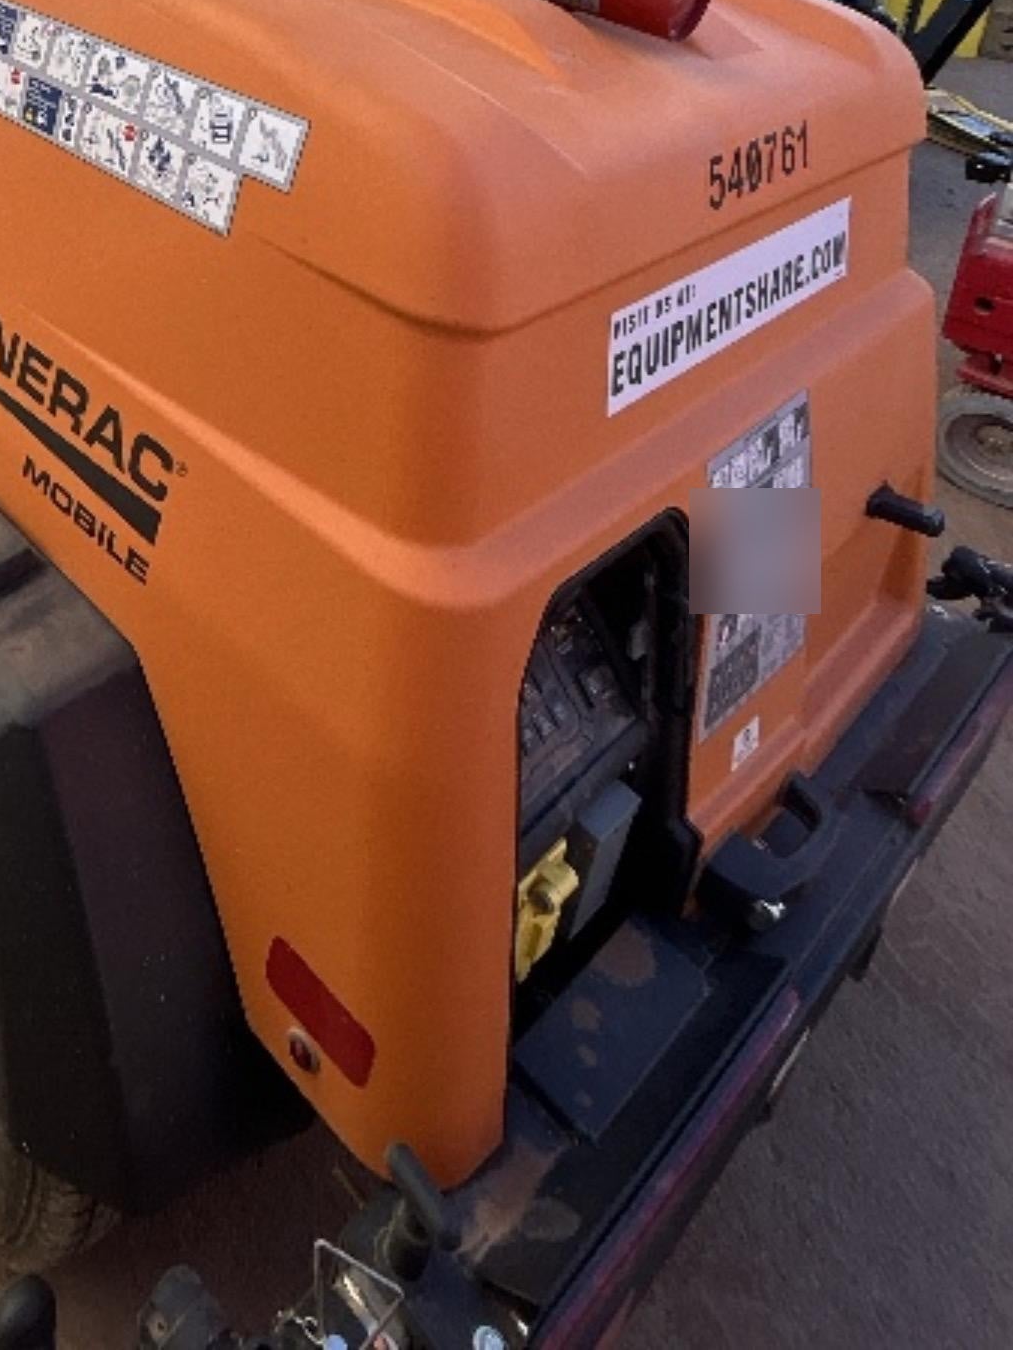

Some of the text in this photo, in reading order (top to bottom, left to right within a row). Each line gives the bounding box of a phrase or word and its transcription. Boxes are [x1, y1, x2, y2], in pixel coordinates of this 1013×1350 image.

[708, 119, 808, 211] 540761
[610, 230, 847, 398] EQUIPMENTSHARE.COM
[22, 454, 151, 586] MOBILE
